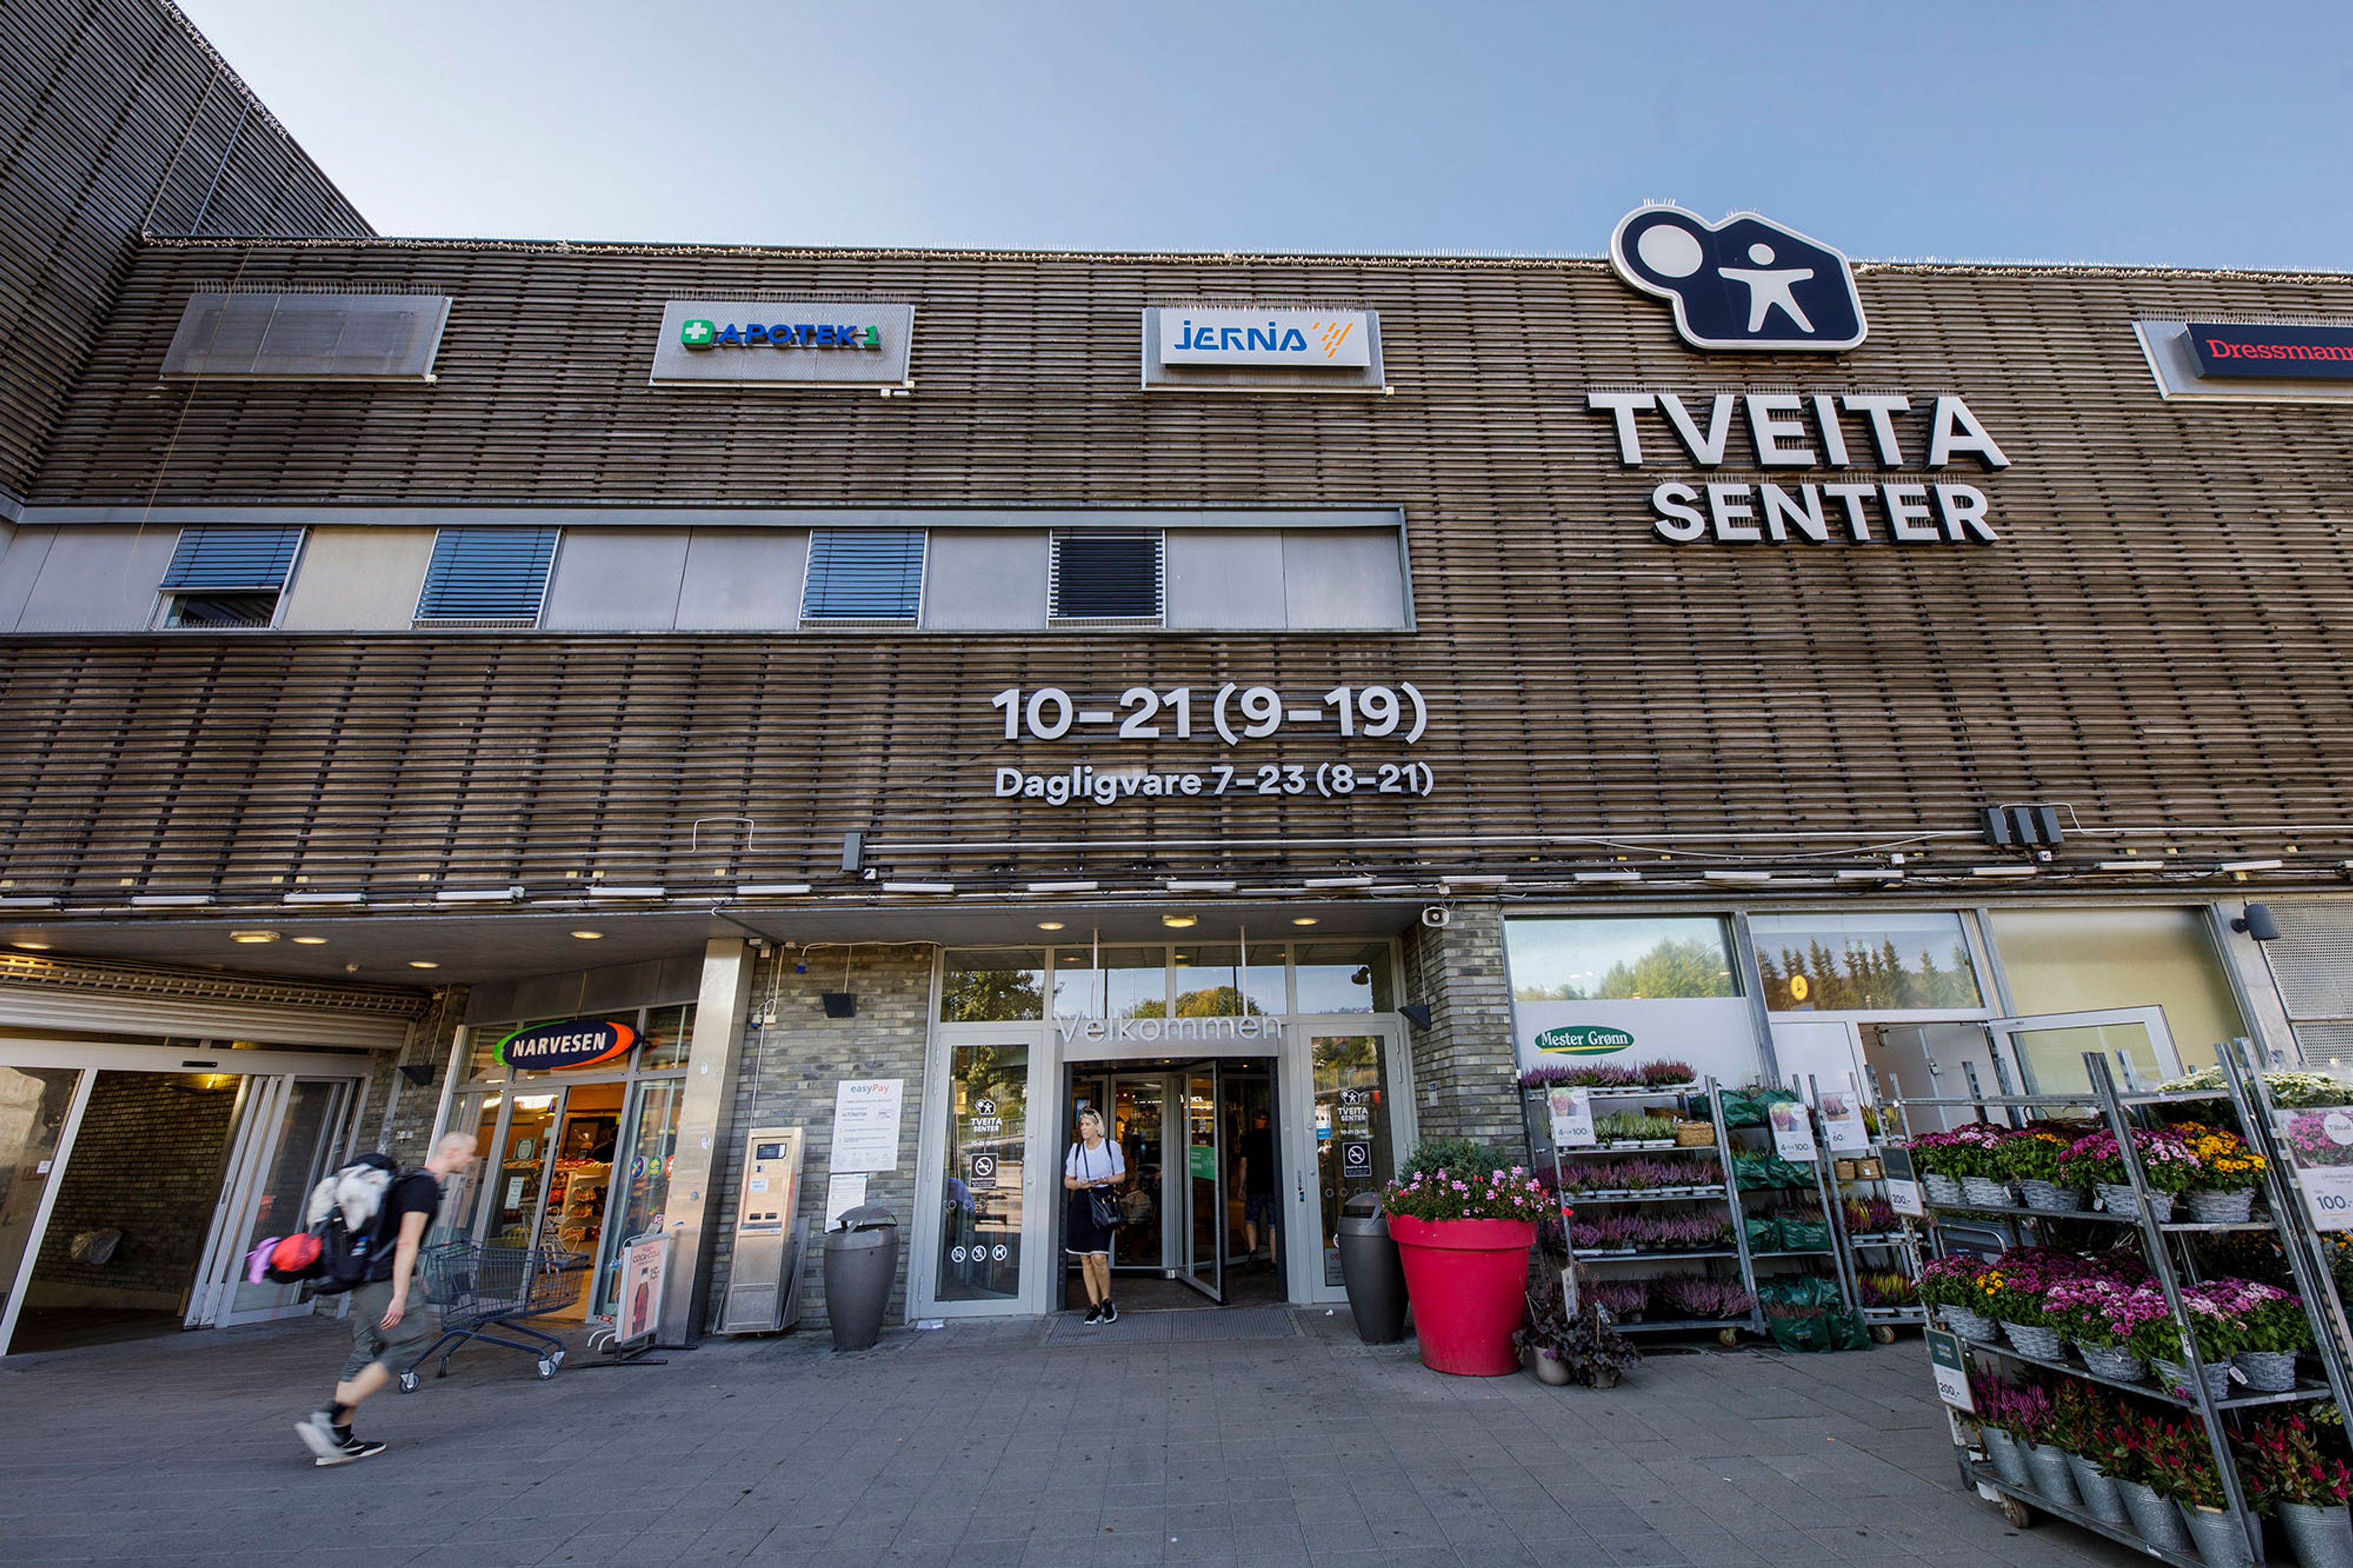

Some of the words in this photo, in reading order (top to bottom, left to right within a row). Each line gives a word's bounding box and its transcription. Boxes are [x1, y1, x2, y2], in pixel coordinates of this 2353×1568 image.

[717, 324, 857, 346] APOTEK
[862, 325, 880, 346] 1
[1587, 393, 2012, 469] TVEITA
[1652, 483, 2000, 543] SENTER
[995, 766, 1202, 806] Dagligvare
[1054, 1011, 1282, 1042] Velkommen
[1541, 1032, 1584, 1046] Mester
[1588, 1031, 1629, 1045] Grønn
[512, 1032, 607, 1058] NARVESEN
[850, 1083, 889, 1094] easyPay
[1337, 1107, 1369, 1115] TVEITA
